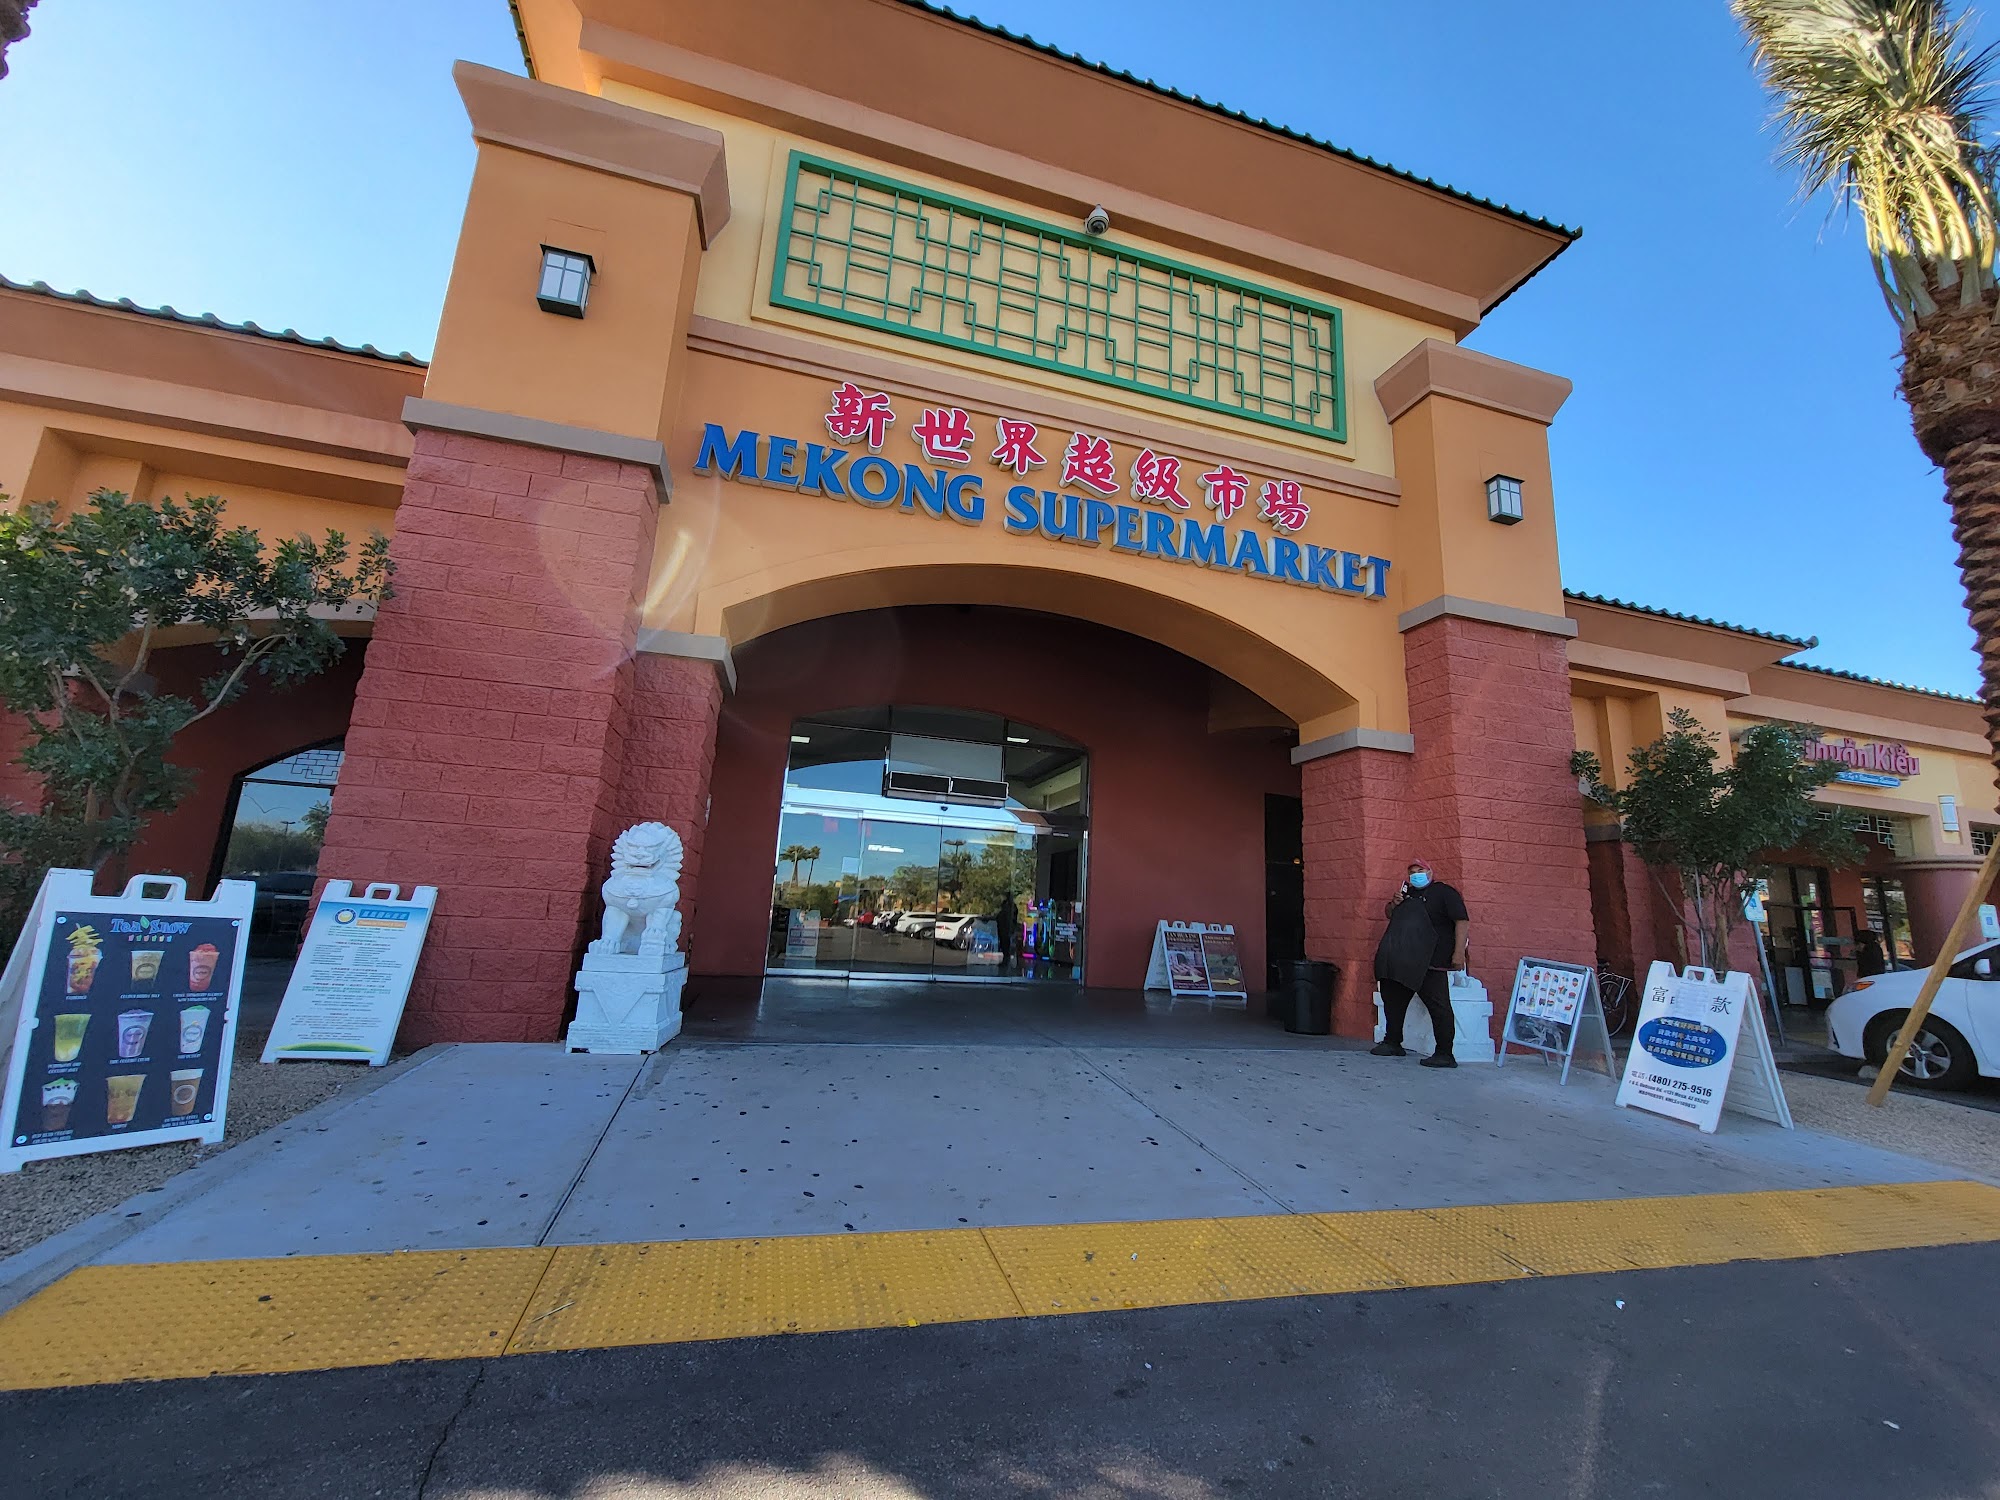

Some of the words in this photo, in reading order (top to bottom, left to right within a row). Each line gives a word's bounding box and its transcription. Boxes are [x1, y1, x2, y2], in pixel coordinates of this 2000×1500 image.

[825, 381, 1310, 534] 新世界超級市場
[694, 423, 986, 526] MEKONG
[1003, 485, 1391, 599] SUPERMARKET
[109, 918, 142, 933] Tea
[148, 919, 192, 935] Snow
[1648, 1073, 1671, 1087] (480)
[1672, 1080, 1712, 1098] 275-9516
